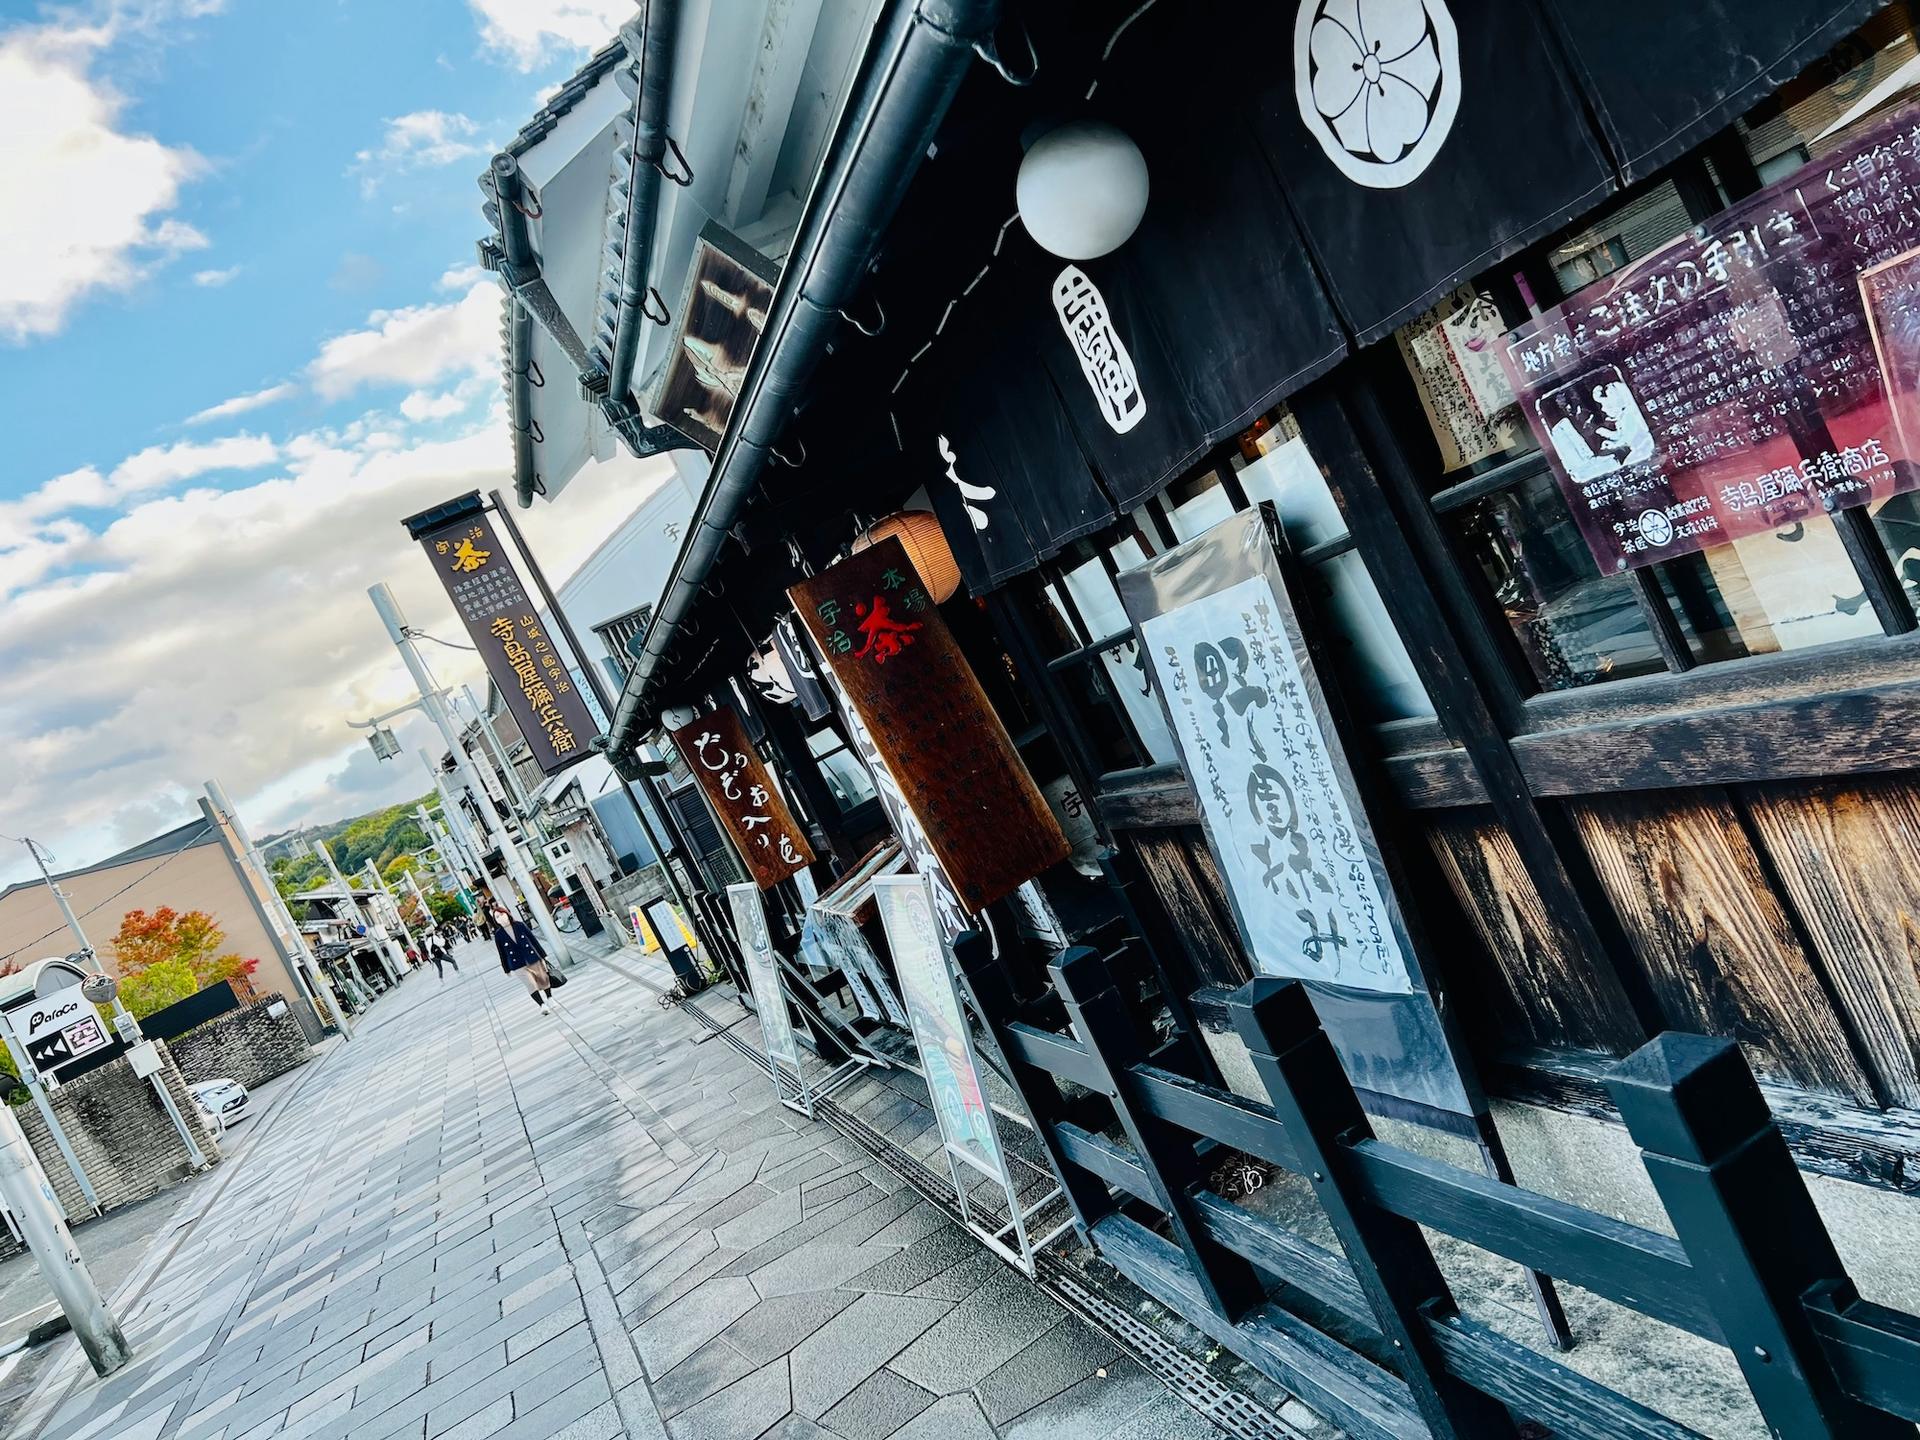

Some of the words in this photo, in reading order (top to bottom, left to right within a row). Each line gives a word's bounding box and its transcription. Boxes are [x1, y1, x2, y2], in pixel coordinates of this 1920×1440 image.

[1719, 438, 1890, 512] 寺島屋彌兵衛商店
[1611, 517, 1639, 537] 宇治
[1620, 536, 1648, 555] 茶匠
[451, 537, 491, 574] 茶
[880, 568, 928, 613] 本場
[816, 600, 853, 655] 宇治
[854, 595, 923, 664] 茶
